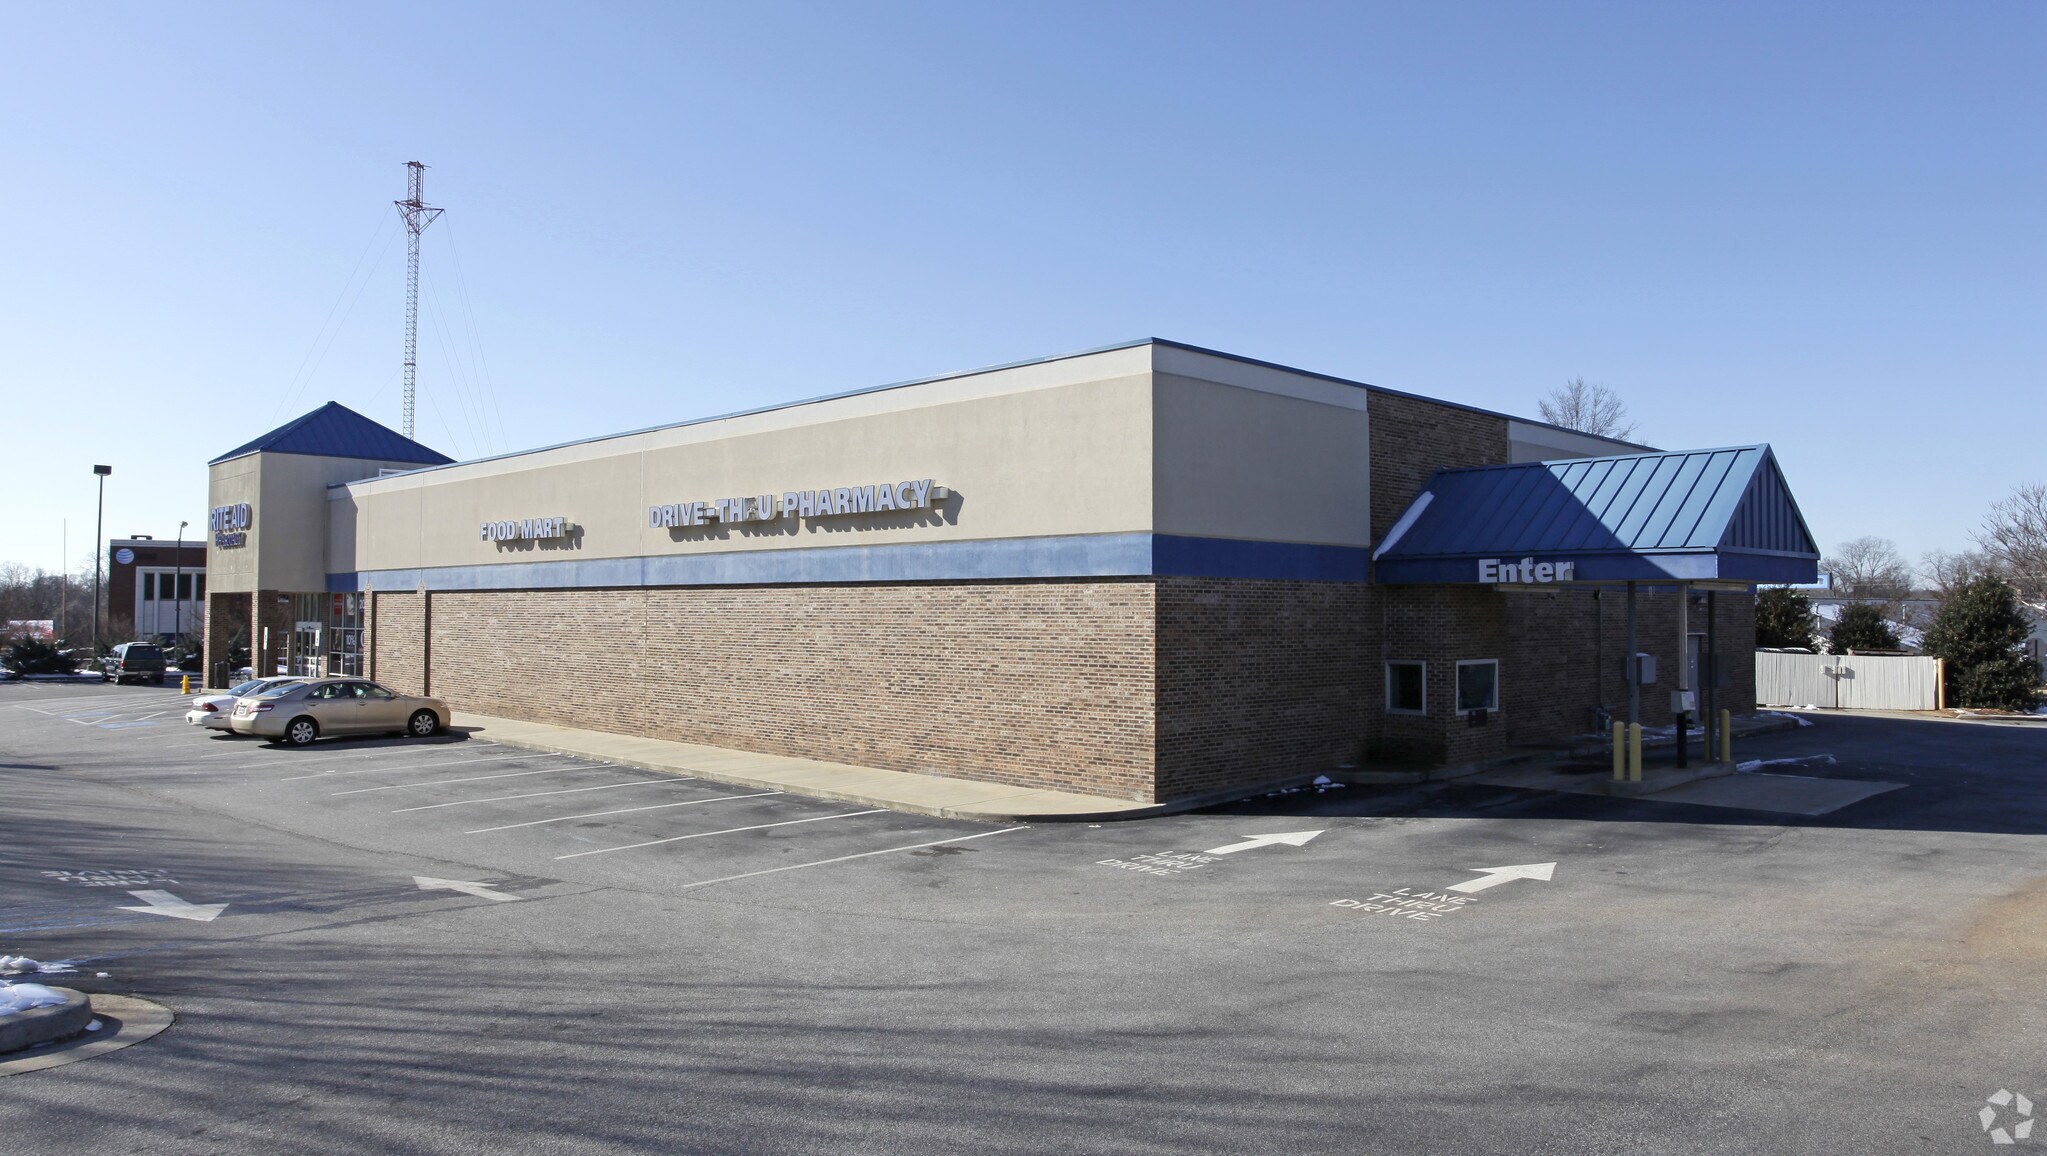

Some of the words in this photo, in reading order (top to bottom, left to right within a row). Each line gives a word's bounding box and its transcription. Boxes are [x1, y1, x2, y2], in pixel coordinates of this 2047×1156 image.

[783, 479, 932, 518] PHARMACY
[211, 506, 229, 531] RITE
[231, 503, 248, 529] AID
[480, 521, 517, 541] FOOD
[521, 517, 565, 539] MART
[1478, 557, 1574, 583] Enter
[1131, 854, 1203, 869] THRU
[1155, 850, 1222, 863] LANE
[1096, 859, 1181, 875] DRIVE
[1367, 893, 1463, 912] THRU
[1393, 888, 1478, 905] LANE
[1329, 899, 1442, 920] DRIVE
